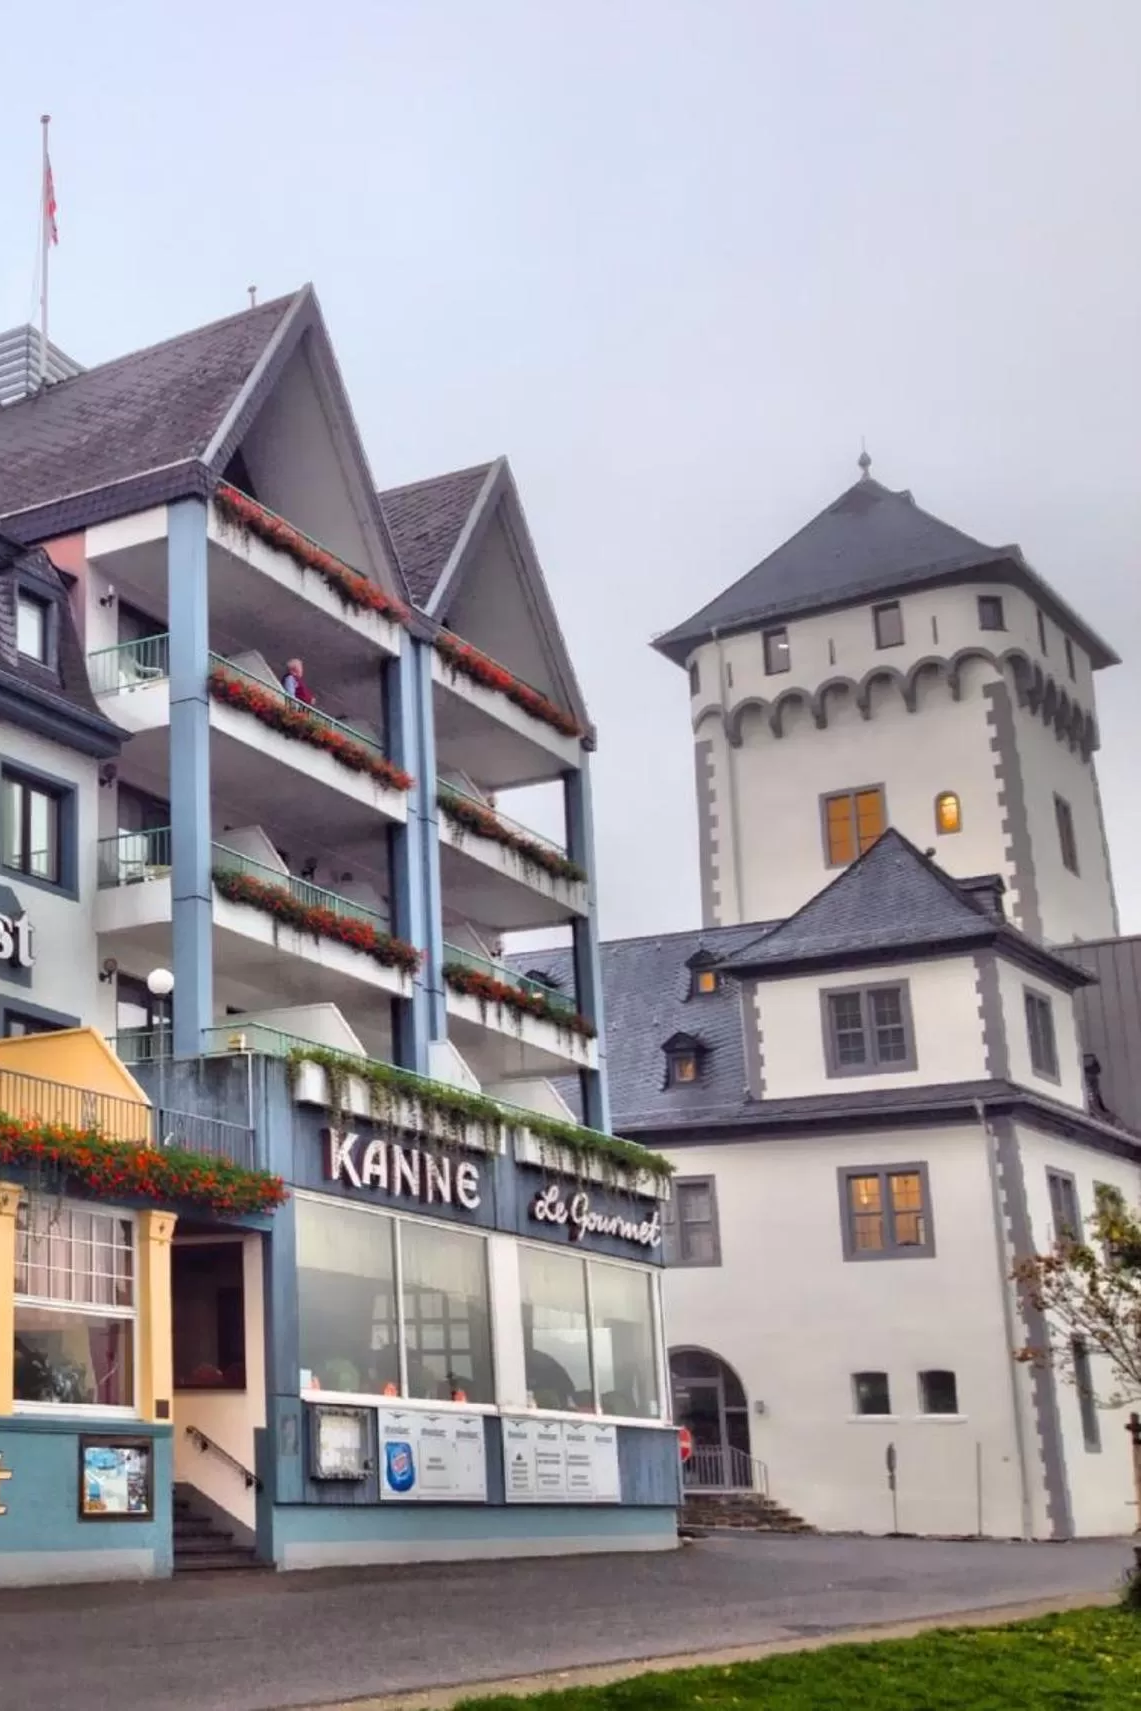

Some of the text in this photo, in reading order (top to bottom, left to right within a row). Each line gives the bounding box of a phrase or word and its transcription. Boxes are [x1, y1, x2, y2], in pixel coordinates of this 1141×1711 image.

[326, 1127, 481, 1210] KANNE
[534, 1184, 661, 1248] Le Gourmet
